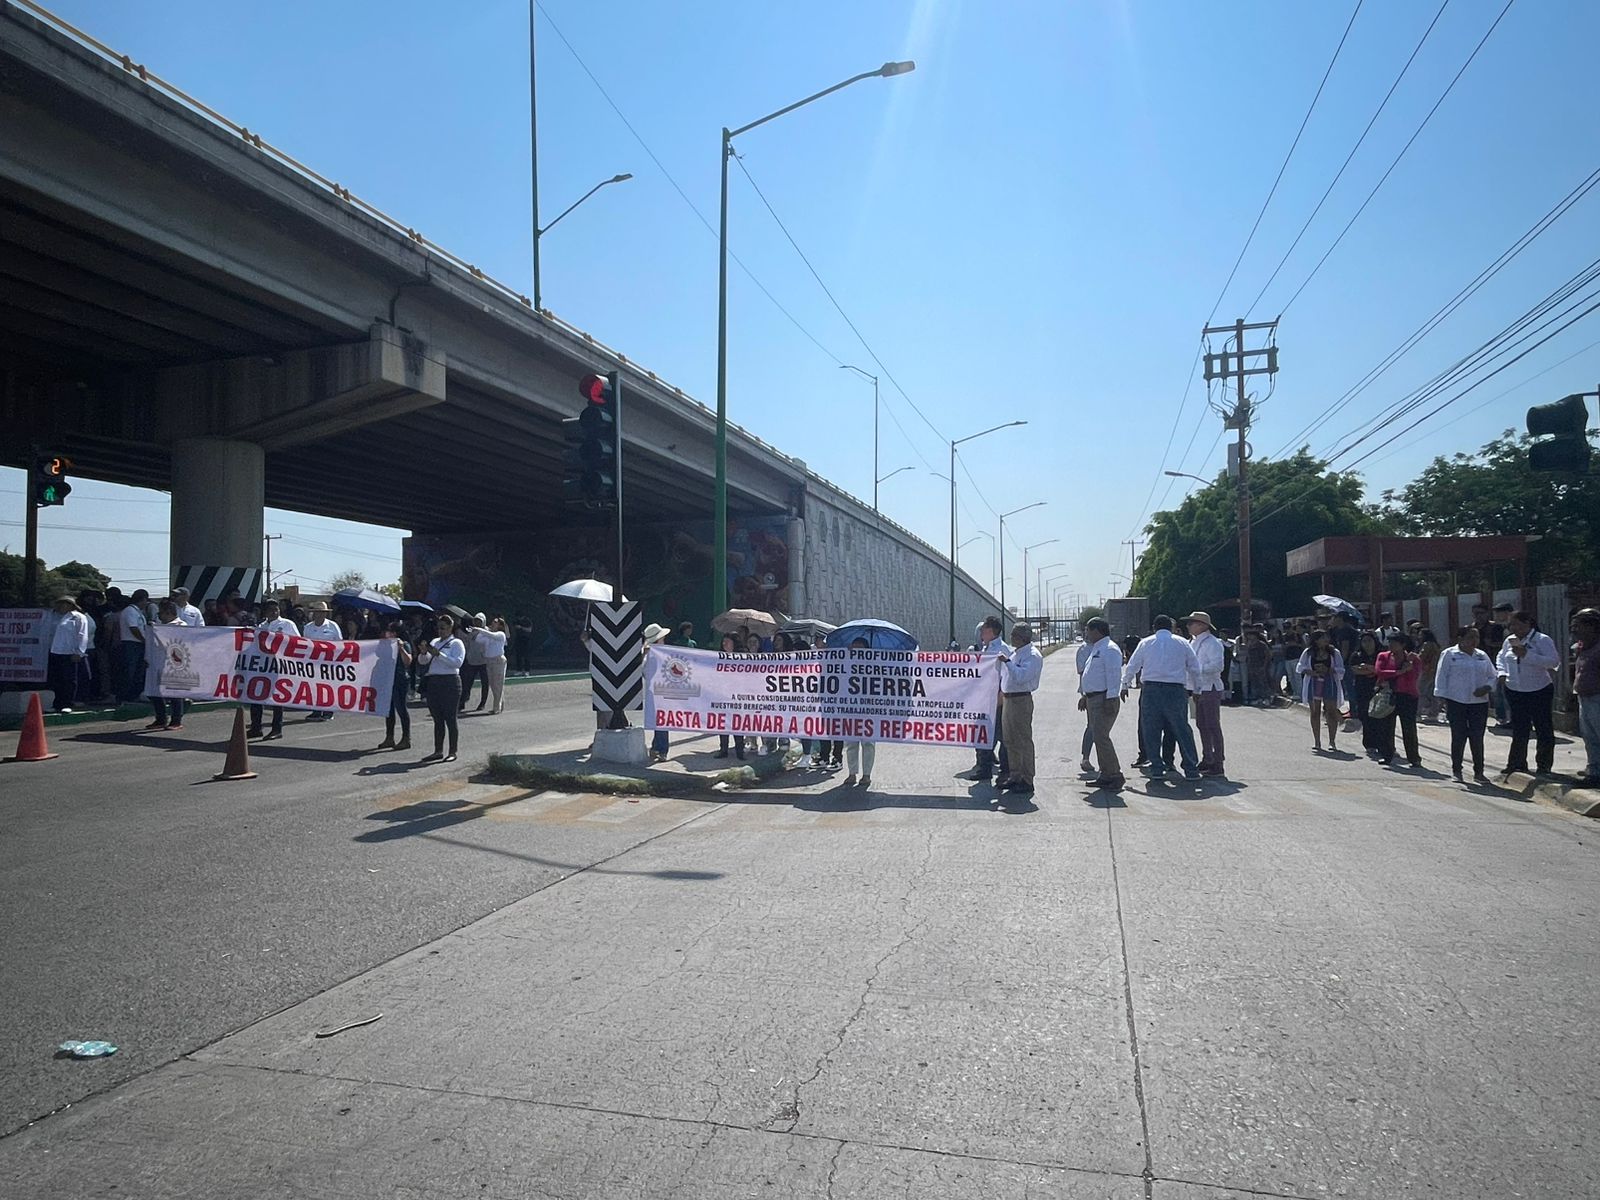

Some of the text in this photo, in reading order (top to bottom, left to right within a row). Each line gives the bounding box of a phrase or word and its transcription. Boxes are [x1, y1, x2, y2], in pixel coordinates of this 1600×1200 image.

[51, 458, 61, 475] 2
[234, 628, 361, 663] FUERA
[794, 650, 846, 661] NUESTRO
[850, 650, 913, 662] PROFUNDO
[917, 652, 970, 664] REPUDIO
[973, 653, 982, 664] Y
[234, 654, 356, 682] ALEJANDRO RIOS
[716, 663, 982, 678] DESCONOCIMIENTO DEL SECRETARIO GENERAL
[213, 674, 378, 713] ACOSADOR
[765, 675, 926, 697] SERGIO SIERRA
[711, 702, 742, 710] NUESTROS
[778, 704, 787, 712] SU
[944, 711, 961, 720] DEBE
[757, 694, 805, 703] CONSIDERAMOS
[917, 700, 954, 709] ATROPELLO
[955, 702, 965, 710] DE
[655, 709, 989, 745] BASTA DE DAÑAR A QUIENES REPRESENTA
